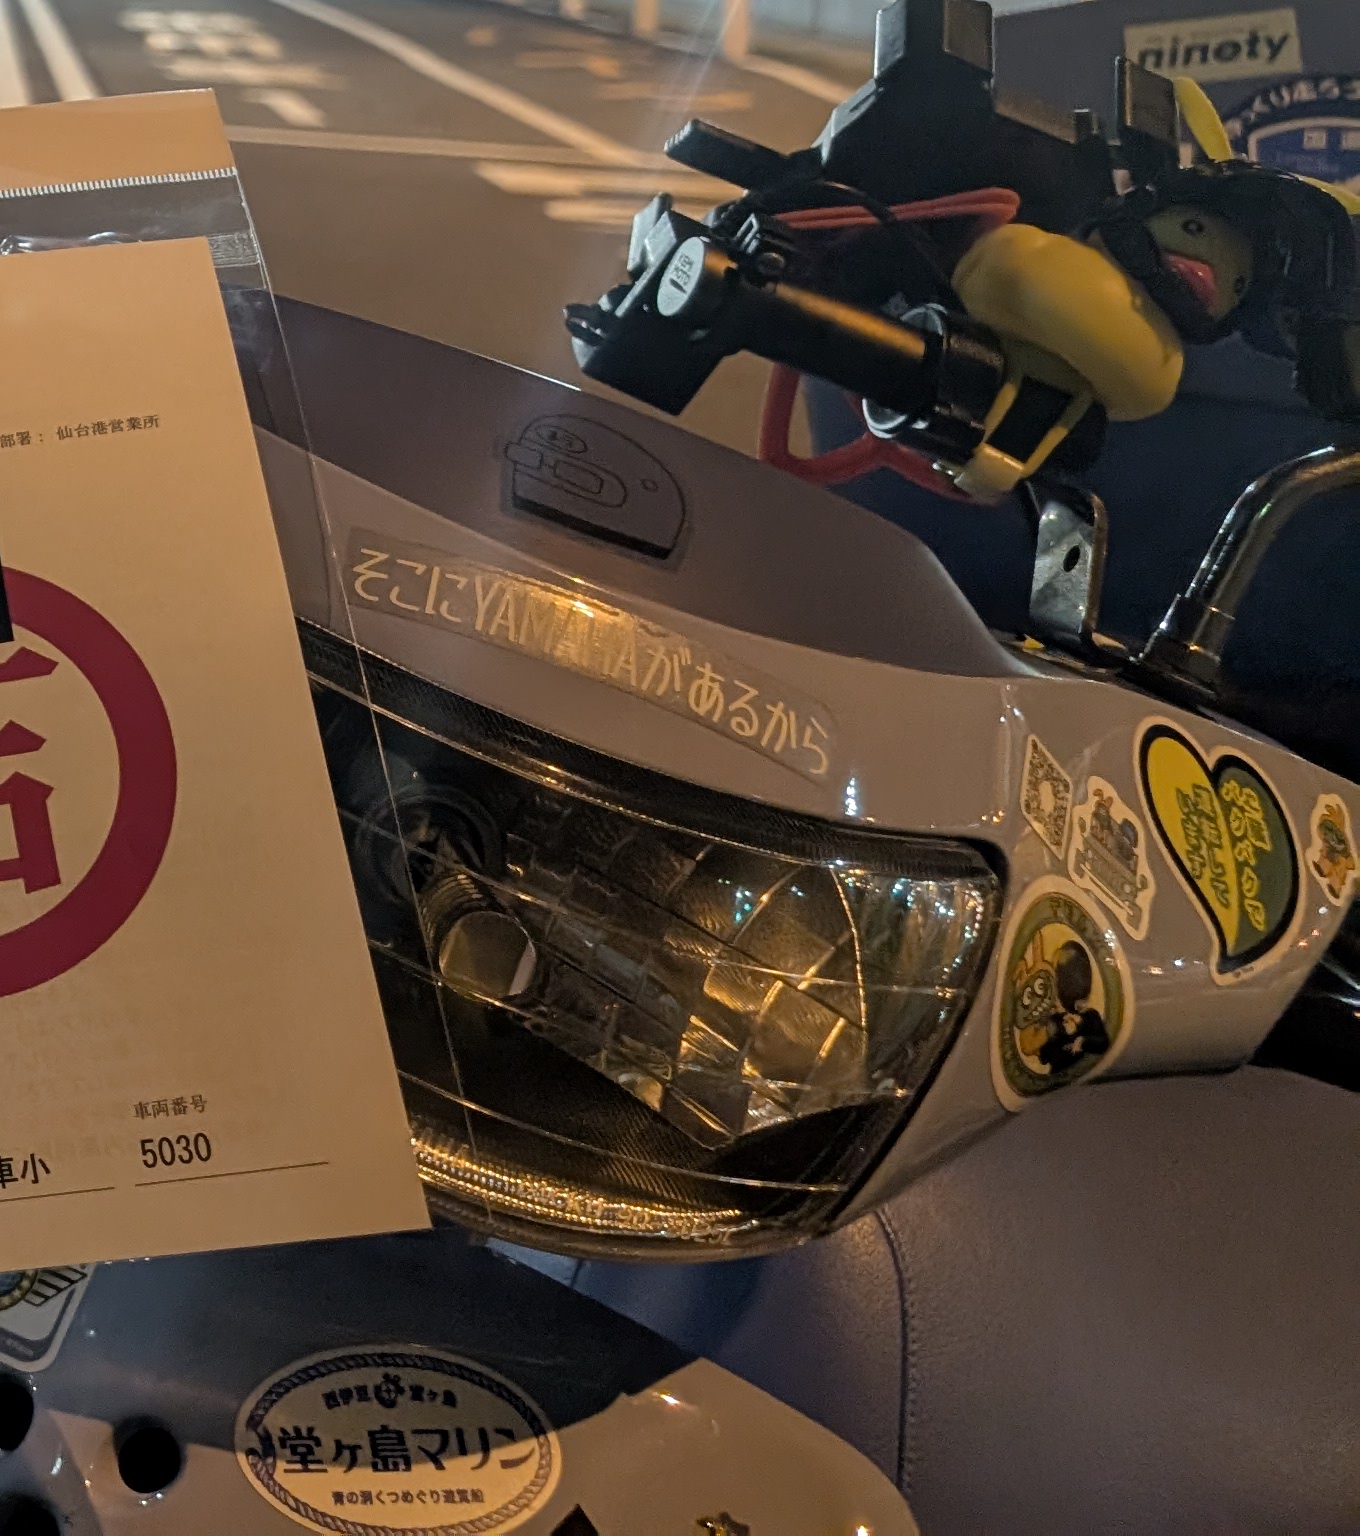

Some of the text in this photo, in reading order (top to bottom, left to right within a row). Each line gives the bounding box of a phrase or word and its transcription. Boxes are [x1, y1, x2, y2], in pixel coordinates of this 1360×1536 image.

[56, 414, 160, 441] 仙台港営業所
[133, 1093, 208, 1121] 車両番号
[139, 1131, 213, 1169] 5030
[279, 1423, 538, 1476] 堂ヶ島マリン
